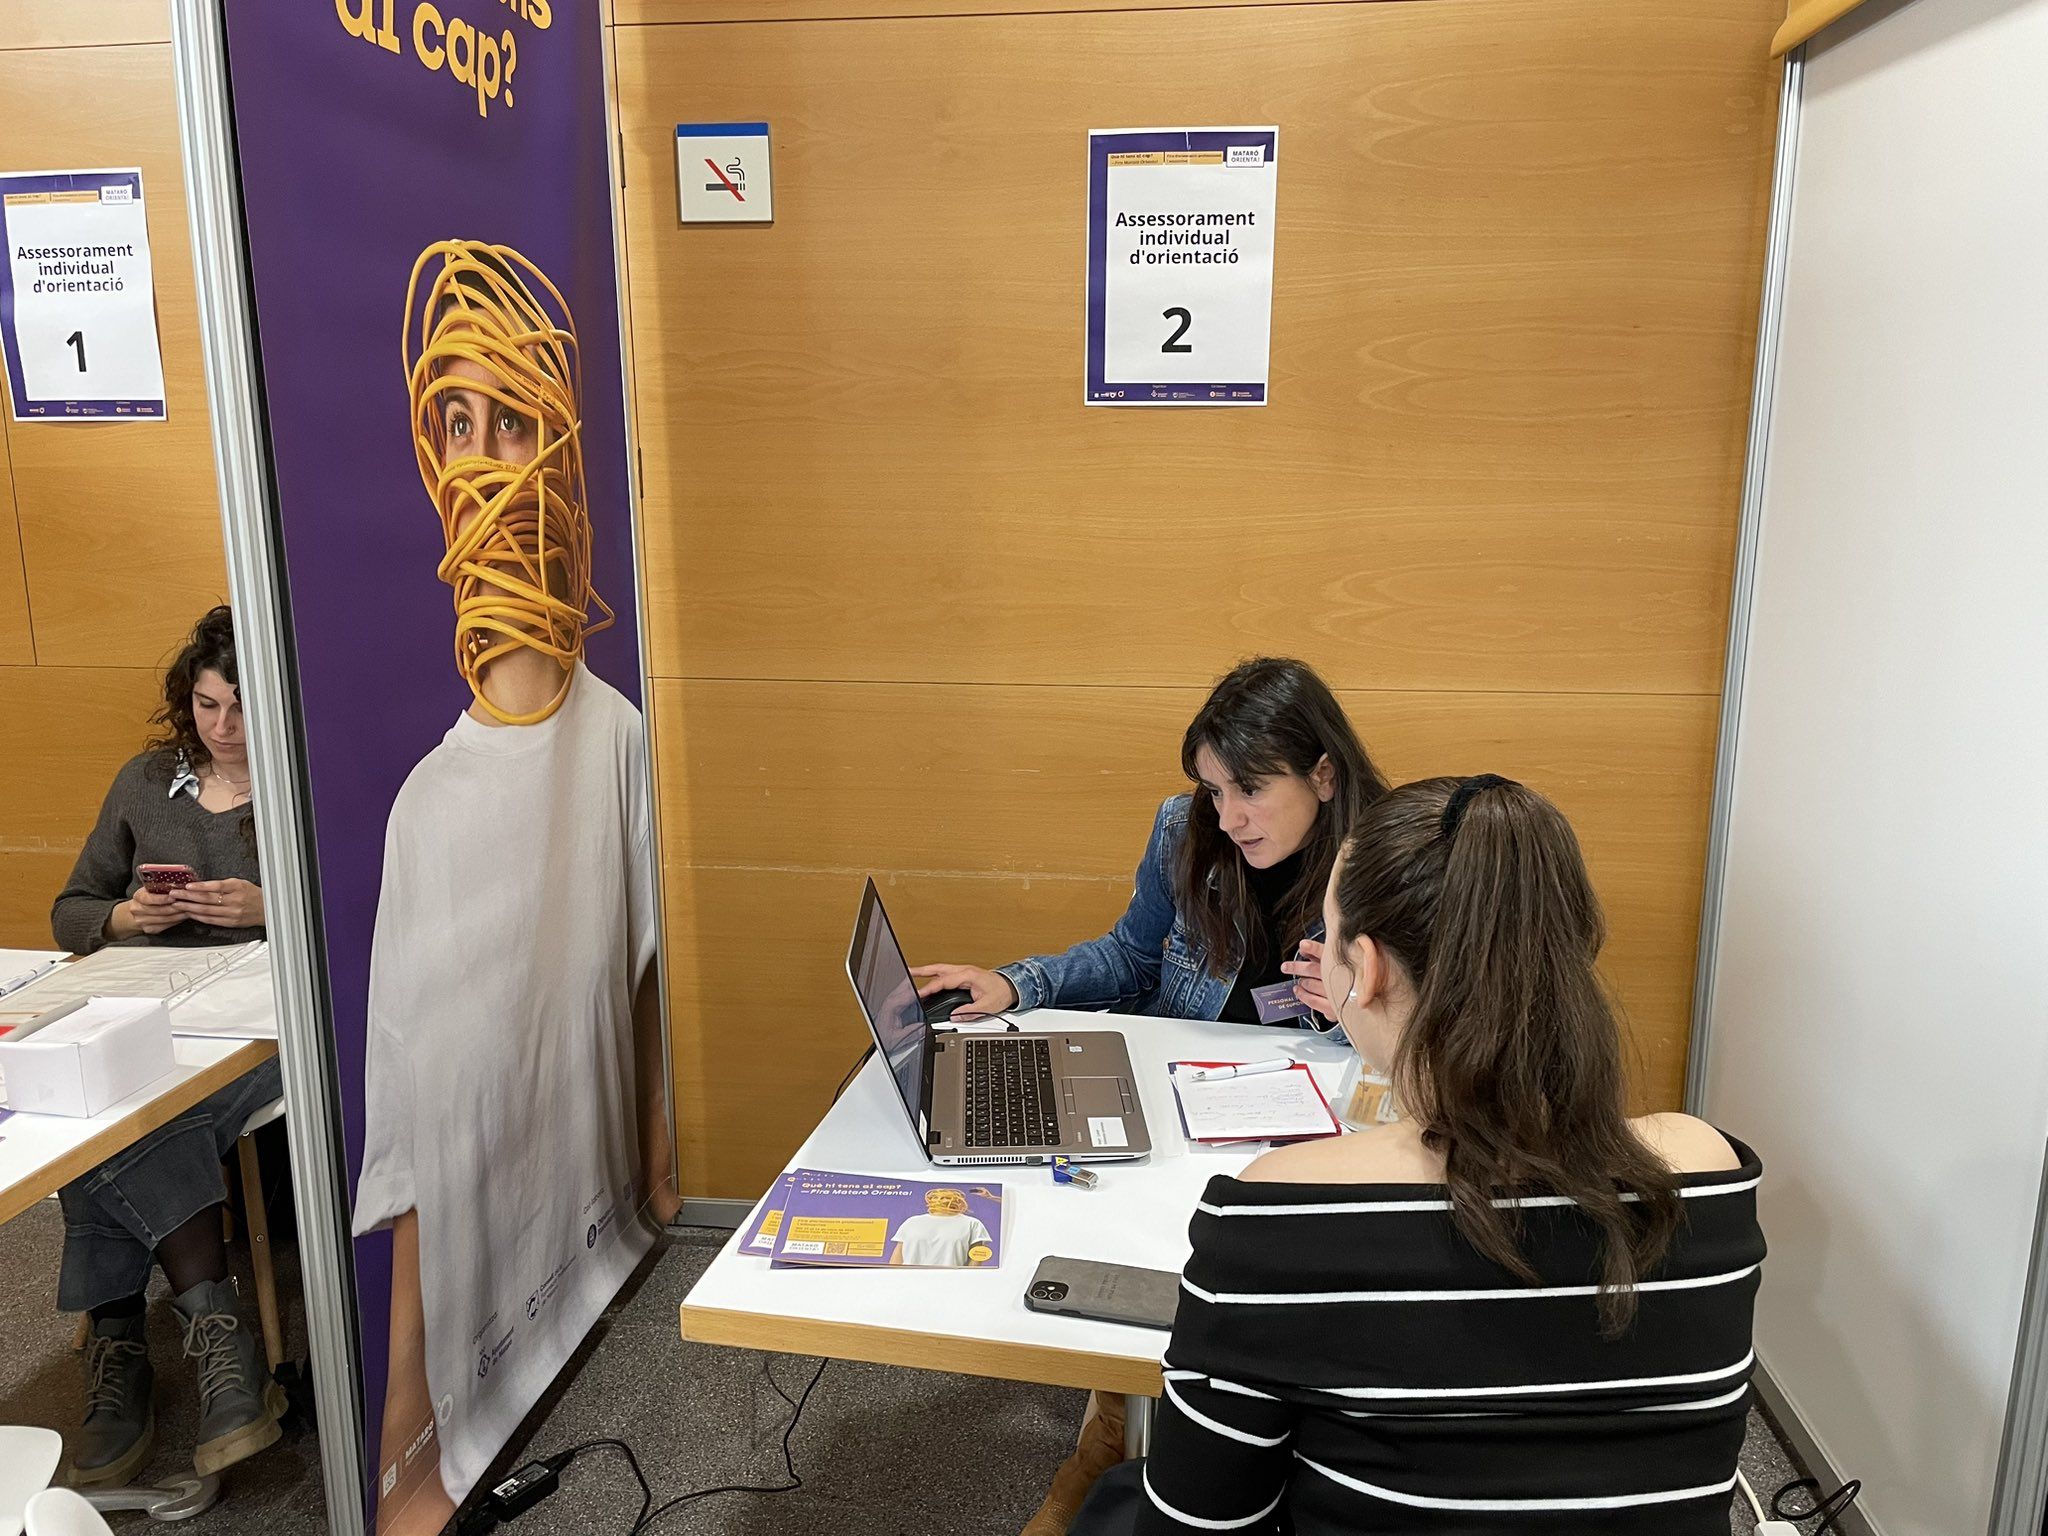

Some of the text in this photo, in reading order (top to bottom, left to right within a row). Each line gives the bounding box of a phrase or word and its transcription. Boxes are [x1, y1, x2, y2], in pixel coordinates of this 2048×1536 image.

[412, 1, 518, 119] cap?
[1232, 149, 1260, 157] MATARÓ
[1115, 210, 1256, 228] Assessorament
[1139, 229, 1230, 247] individual
[17, 243, 134, 260] Assessorament
[1129, 248, 1239, 265] d'orientació
[38, 260, 115, 276] individual
[33, 277, 124, 293] d'orientació
[1161, 306, 1192, 353] 2
[66, 331, 87, 372] 1
